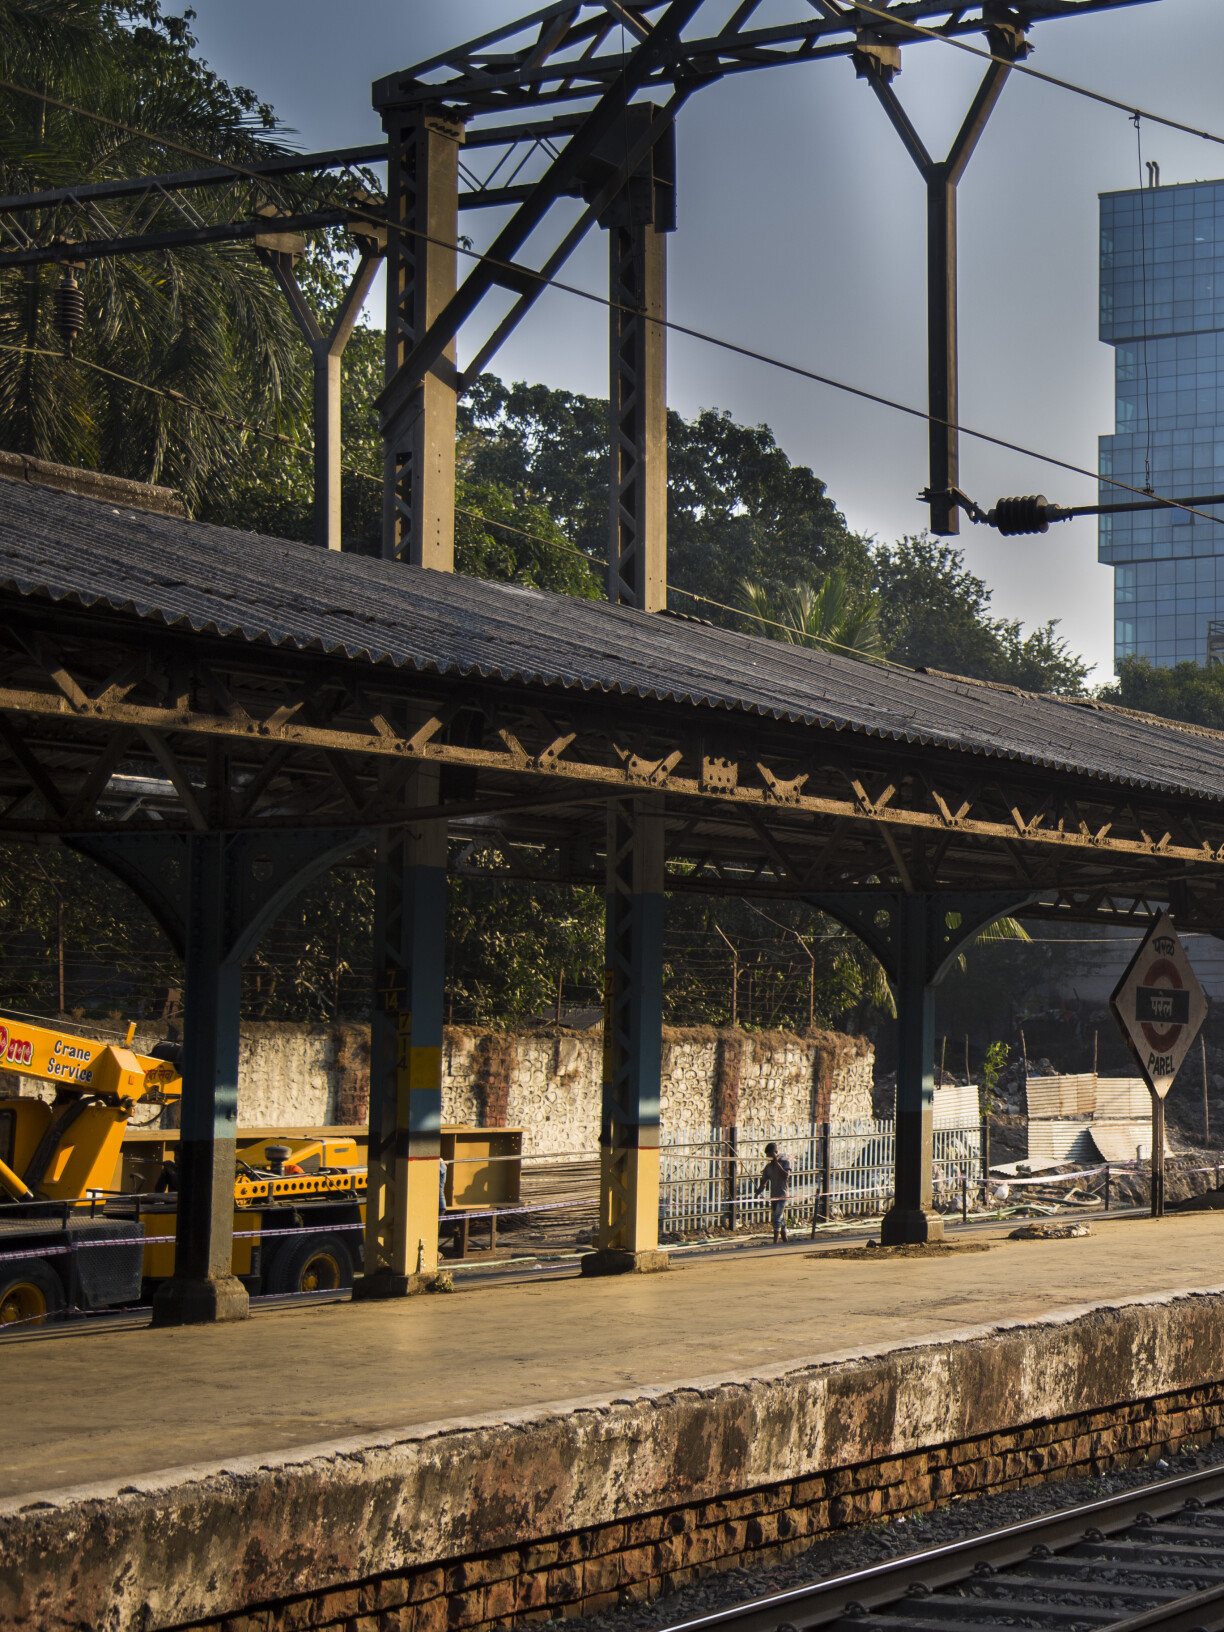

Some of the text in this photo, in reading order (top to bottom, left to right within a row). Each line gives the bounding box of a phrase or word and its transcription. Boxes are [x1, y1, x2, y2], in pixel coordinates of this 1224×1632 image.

[54, 1039, 91, 1062] Crane
[47, 1057, 93, 1083] Service
[1147, 1052, 1175, 1076] PAREL
